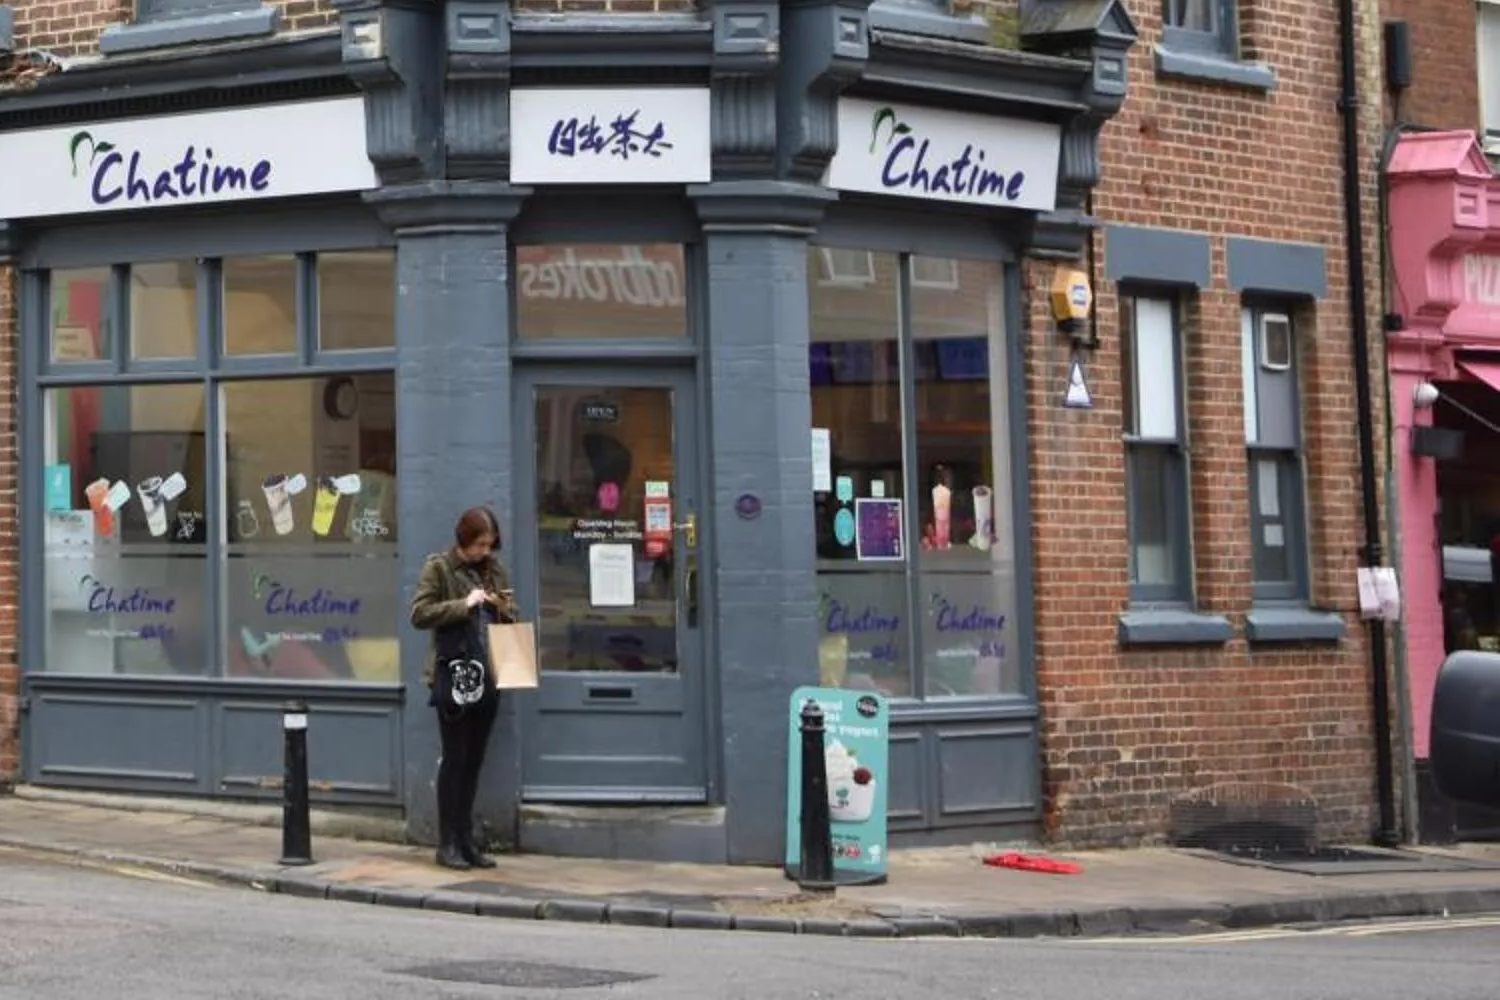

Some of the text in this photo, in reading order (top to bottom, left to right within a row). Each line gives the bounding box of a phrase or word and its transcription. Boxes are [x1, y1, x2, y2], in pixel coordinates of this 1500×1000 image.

[91, 145, 272, 205] Chatime
[880, 135, 1025, 200] Chatime
[88, 587, 176, 614] Chatime
[265, 587, 361, 615] Chatime
[827, 603, 900, 633] Chatime
[936, 603, 1006, 632] Chatime
